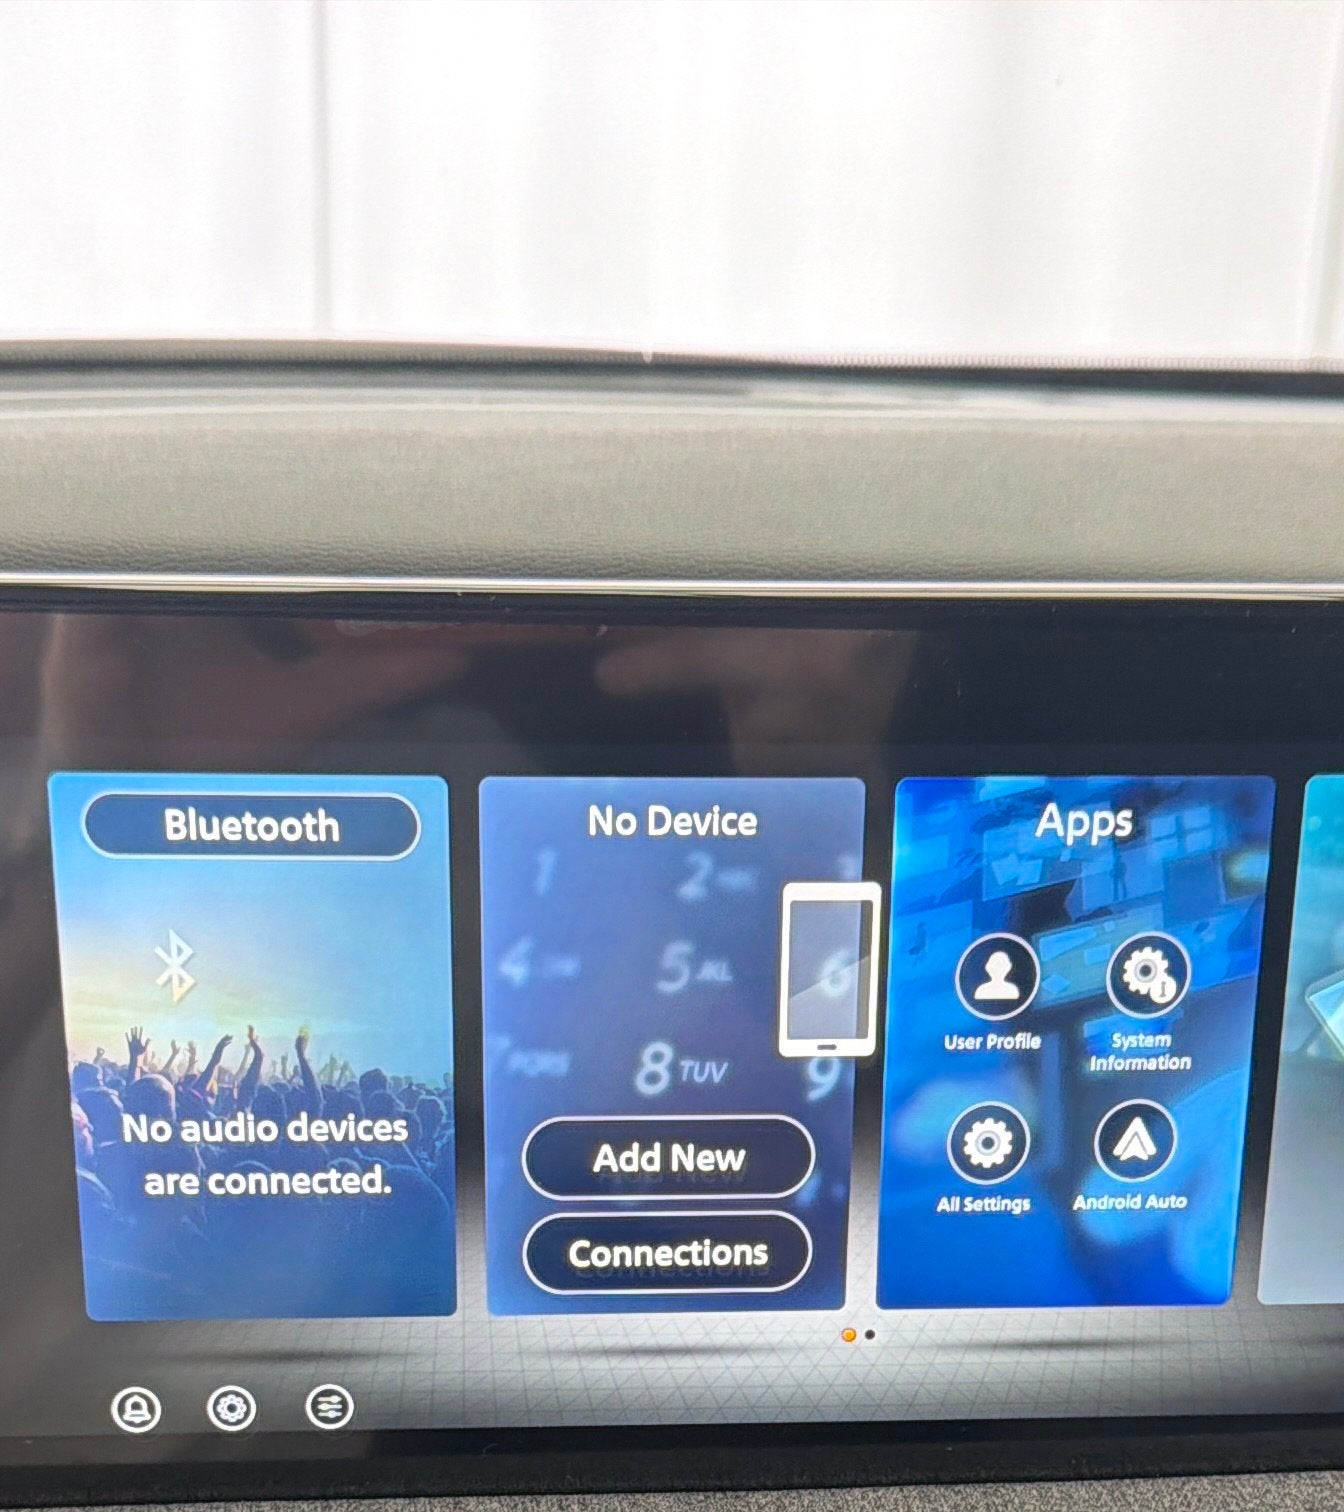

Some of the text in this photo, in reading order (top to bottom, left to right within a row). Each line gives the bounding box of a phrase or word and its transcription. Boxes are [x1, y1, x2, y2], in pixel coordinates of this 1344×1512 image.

[164, 806, 341, 843] Bluetooth
[588, 805, 759, 837] No Device
[1034, 802, 1135, 846] Apps
[656, 940, 696, 994] 5
[944, 1032, 1043, 1051] User Profile
[1111, 1032, 1173, 1052] System
[634, 1040, 729, 1096] 8 TUV
[806, 1055, 843, 1102] 9
[1089, 1054, 1193, 1072] Information
[122, 1111, 409, 1144] No audio devices
[592, 1142, 747, 1174] Add New
[144, 1164, 393, 1196] are connected.
[936, 1195, 1032, 1215] All Settings
[1072, 1193, 1189, 1211] Android Auto
[567, 1239, 770, 1270] Connections
